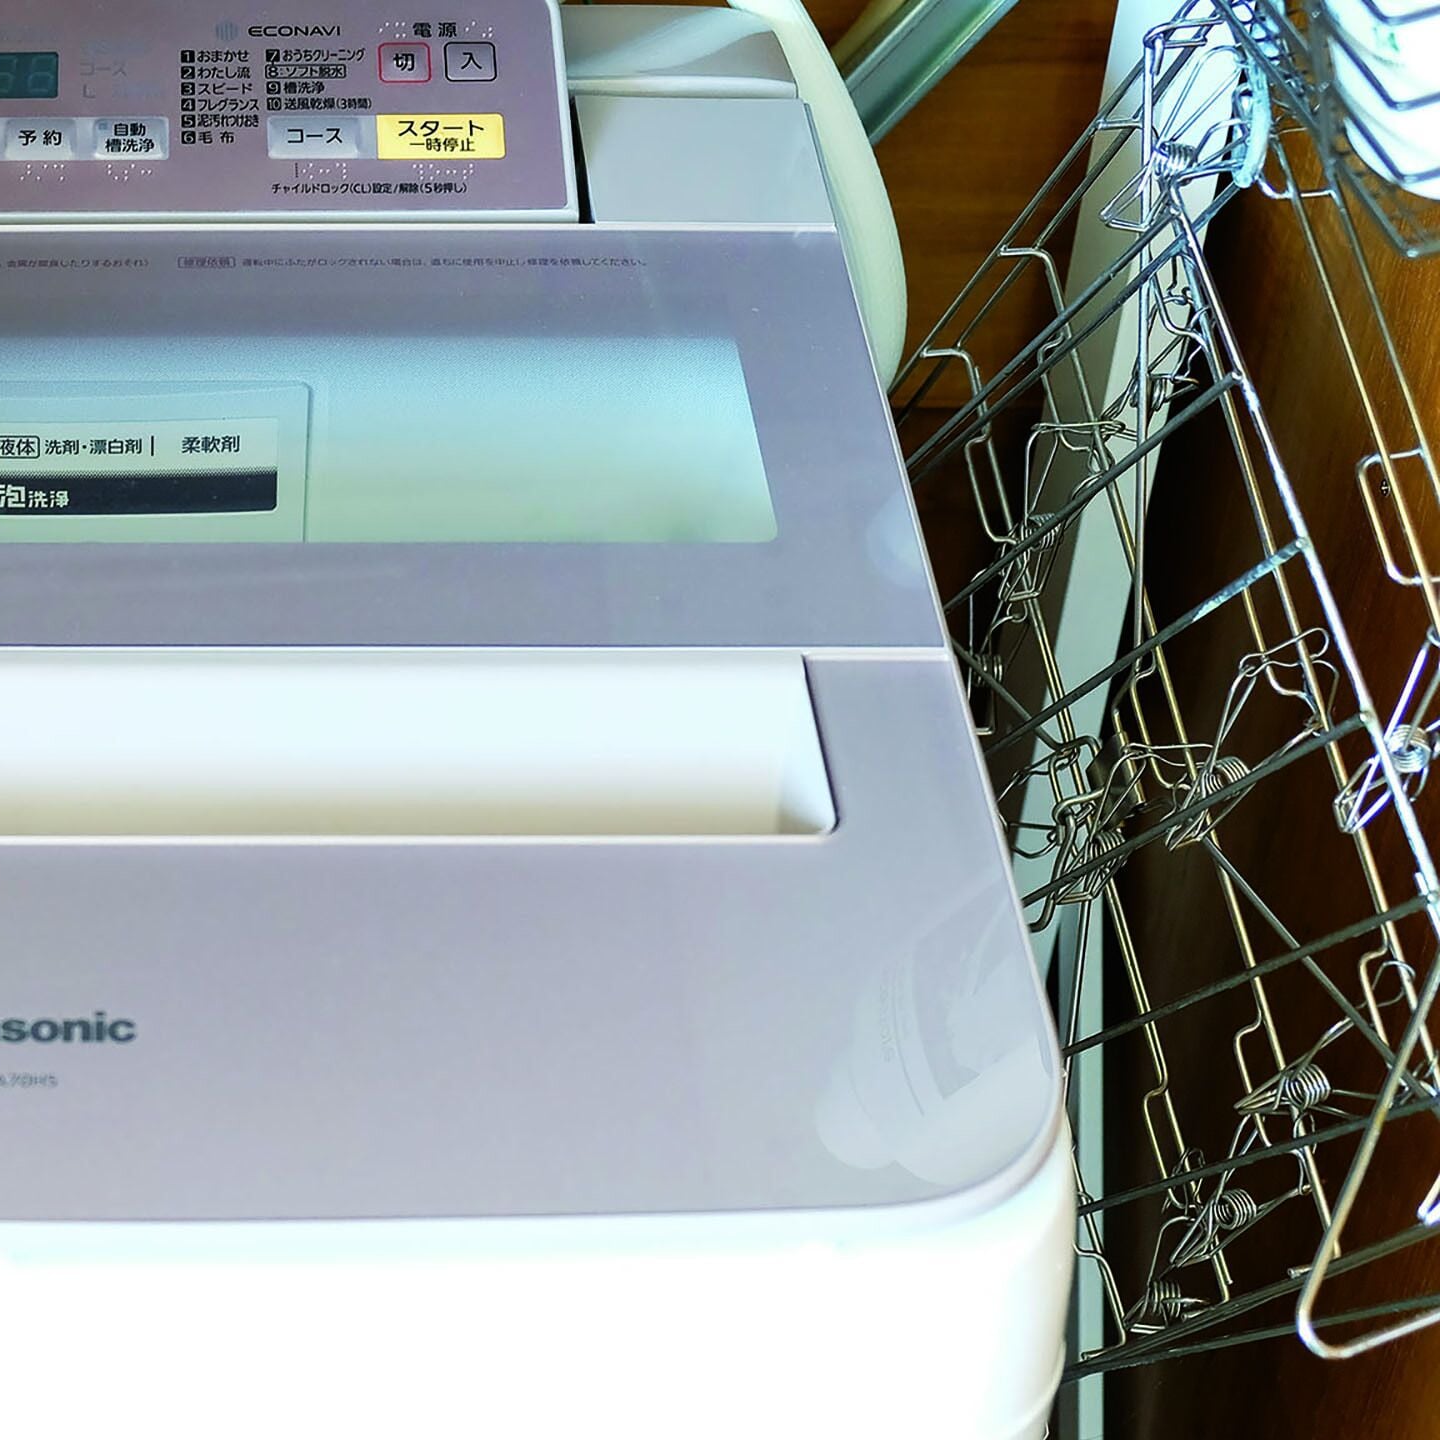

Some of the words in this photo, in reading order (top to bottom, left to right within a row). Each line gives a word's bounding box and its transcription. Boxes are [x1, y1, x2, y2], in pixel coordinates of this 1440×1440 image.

[247, 25, 341, 37] ECONAVI
[412, 22, 457, 38] 電源
[196, 49, 249, 63] おまかせ
[282, 47, 366, 63] おうちクリーニング
[392, 52, 415, 72] 切
[460, 51, 483, 70] 入
[197, 66, 251, 80] わたし流
[198, 82, 253, 96] スピード
[283, 80, 325, 95] 槽洗浄
[197, 97, 260, 112] フレグランス
[197, 113, 259, 128] 泥汚れつけおき
[398, 119, 484, 137] スタート
[113, 122, 146, 137] 自動
[198, 130, 235, 145] 毛布
[287, 127, 343, 144] コース
[18, 129, 62, 147] 予約
[105, 137, 155, 153] 槽洗浄
[409, 137, 475, 153] 一時停止
[44, 438, 143, 456] 洗剤・漂白剤
[181, 435, 241, 454] 柔軟剤
